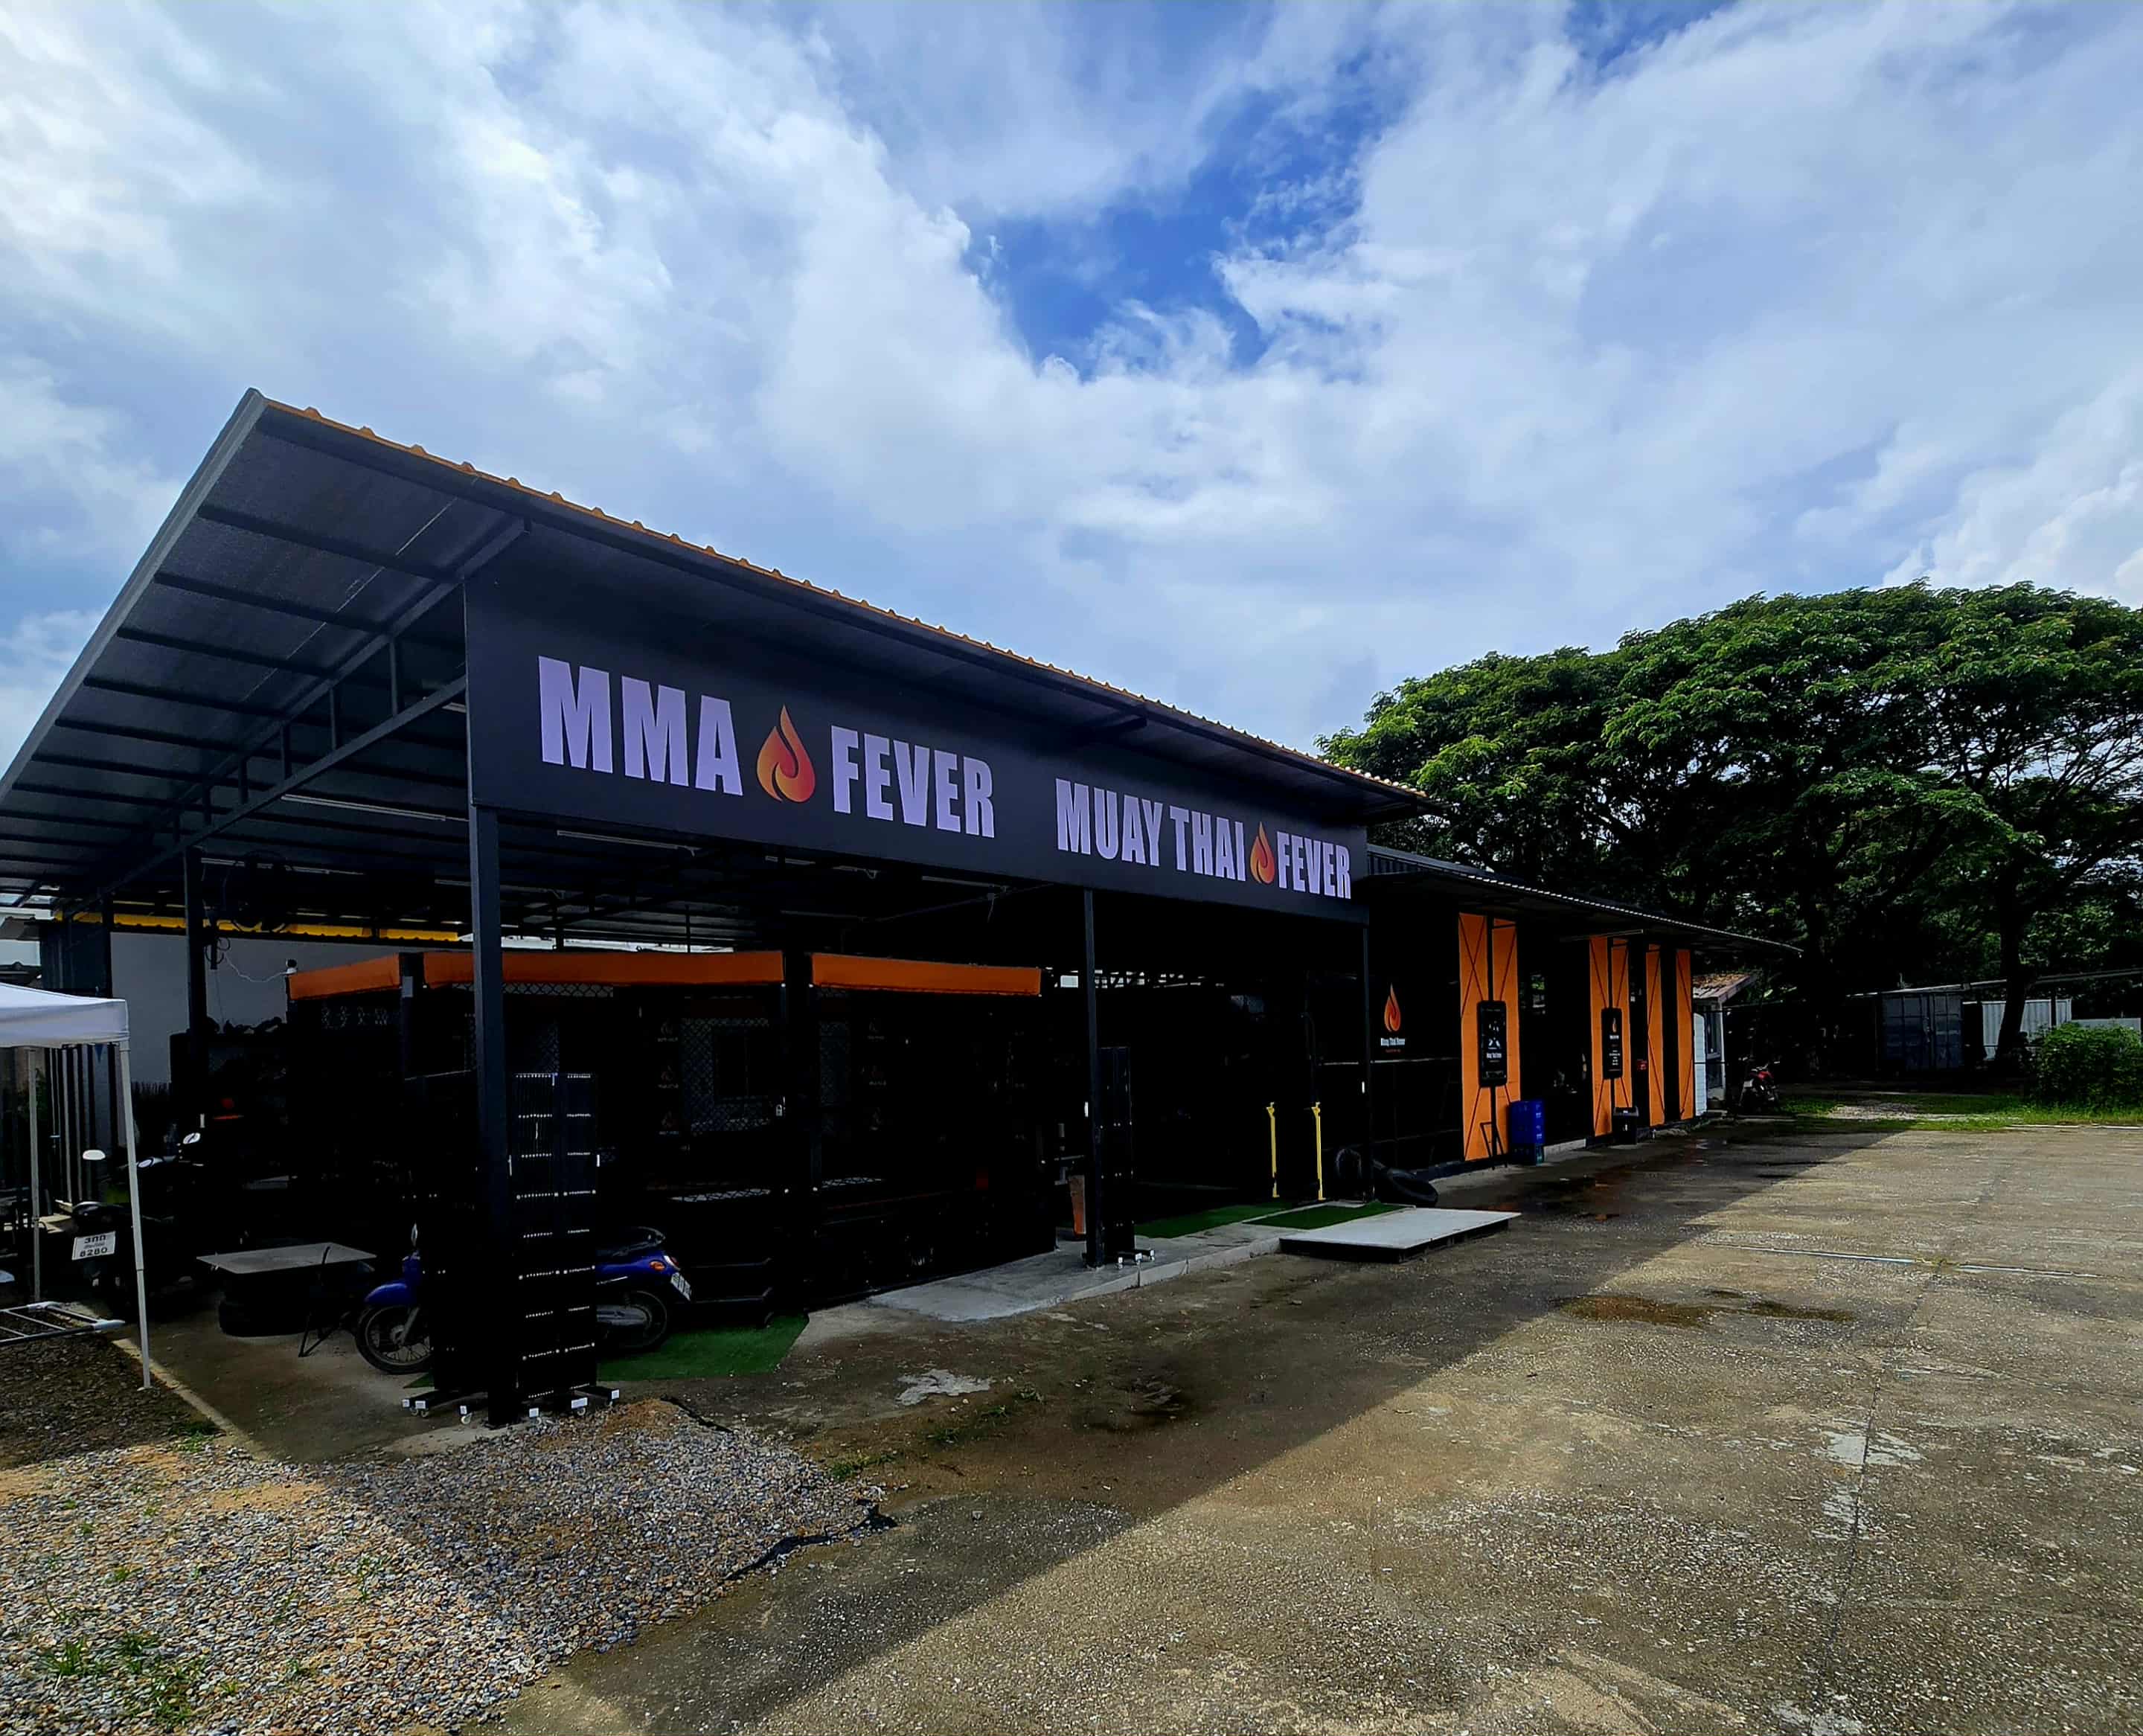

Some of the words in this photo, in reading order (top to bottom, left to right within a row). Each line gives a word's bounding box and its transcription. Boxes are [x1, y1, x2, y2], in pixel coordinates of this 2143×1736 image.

[539, 656, 743, 795] MMA
[831, 725, 994, 838] FEVER
[1055, 778, 1163, 867] MUAY
[1170, 805, 1246, 881] THAI
[1277, 830, 1351, 899] FEVER
